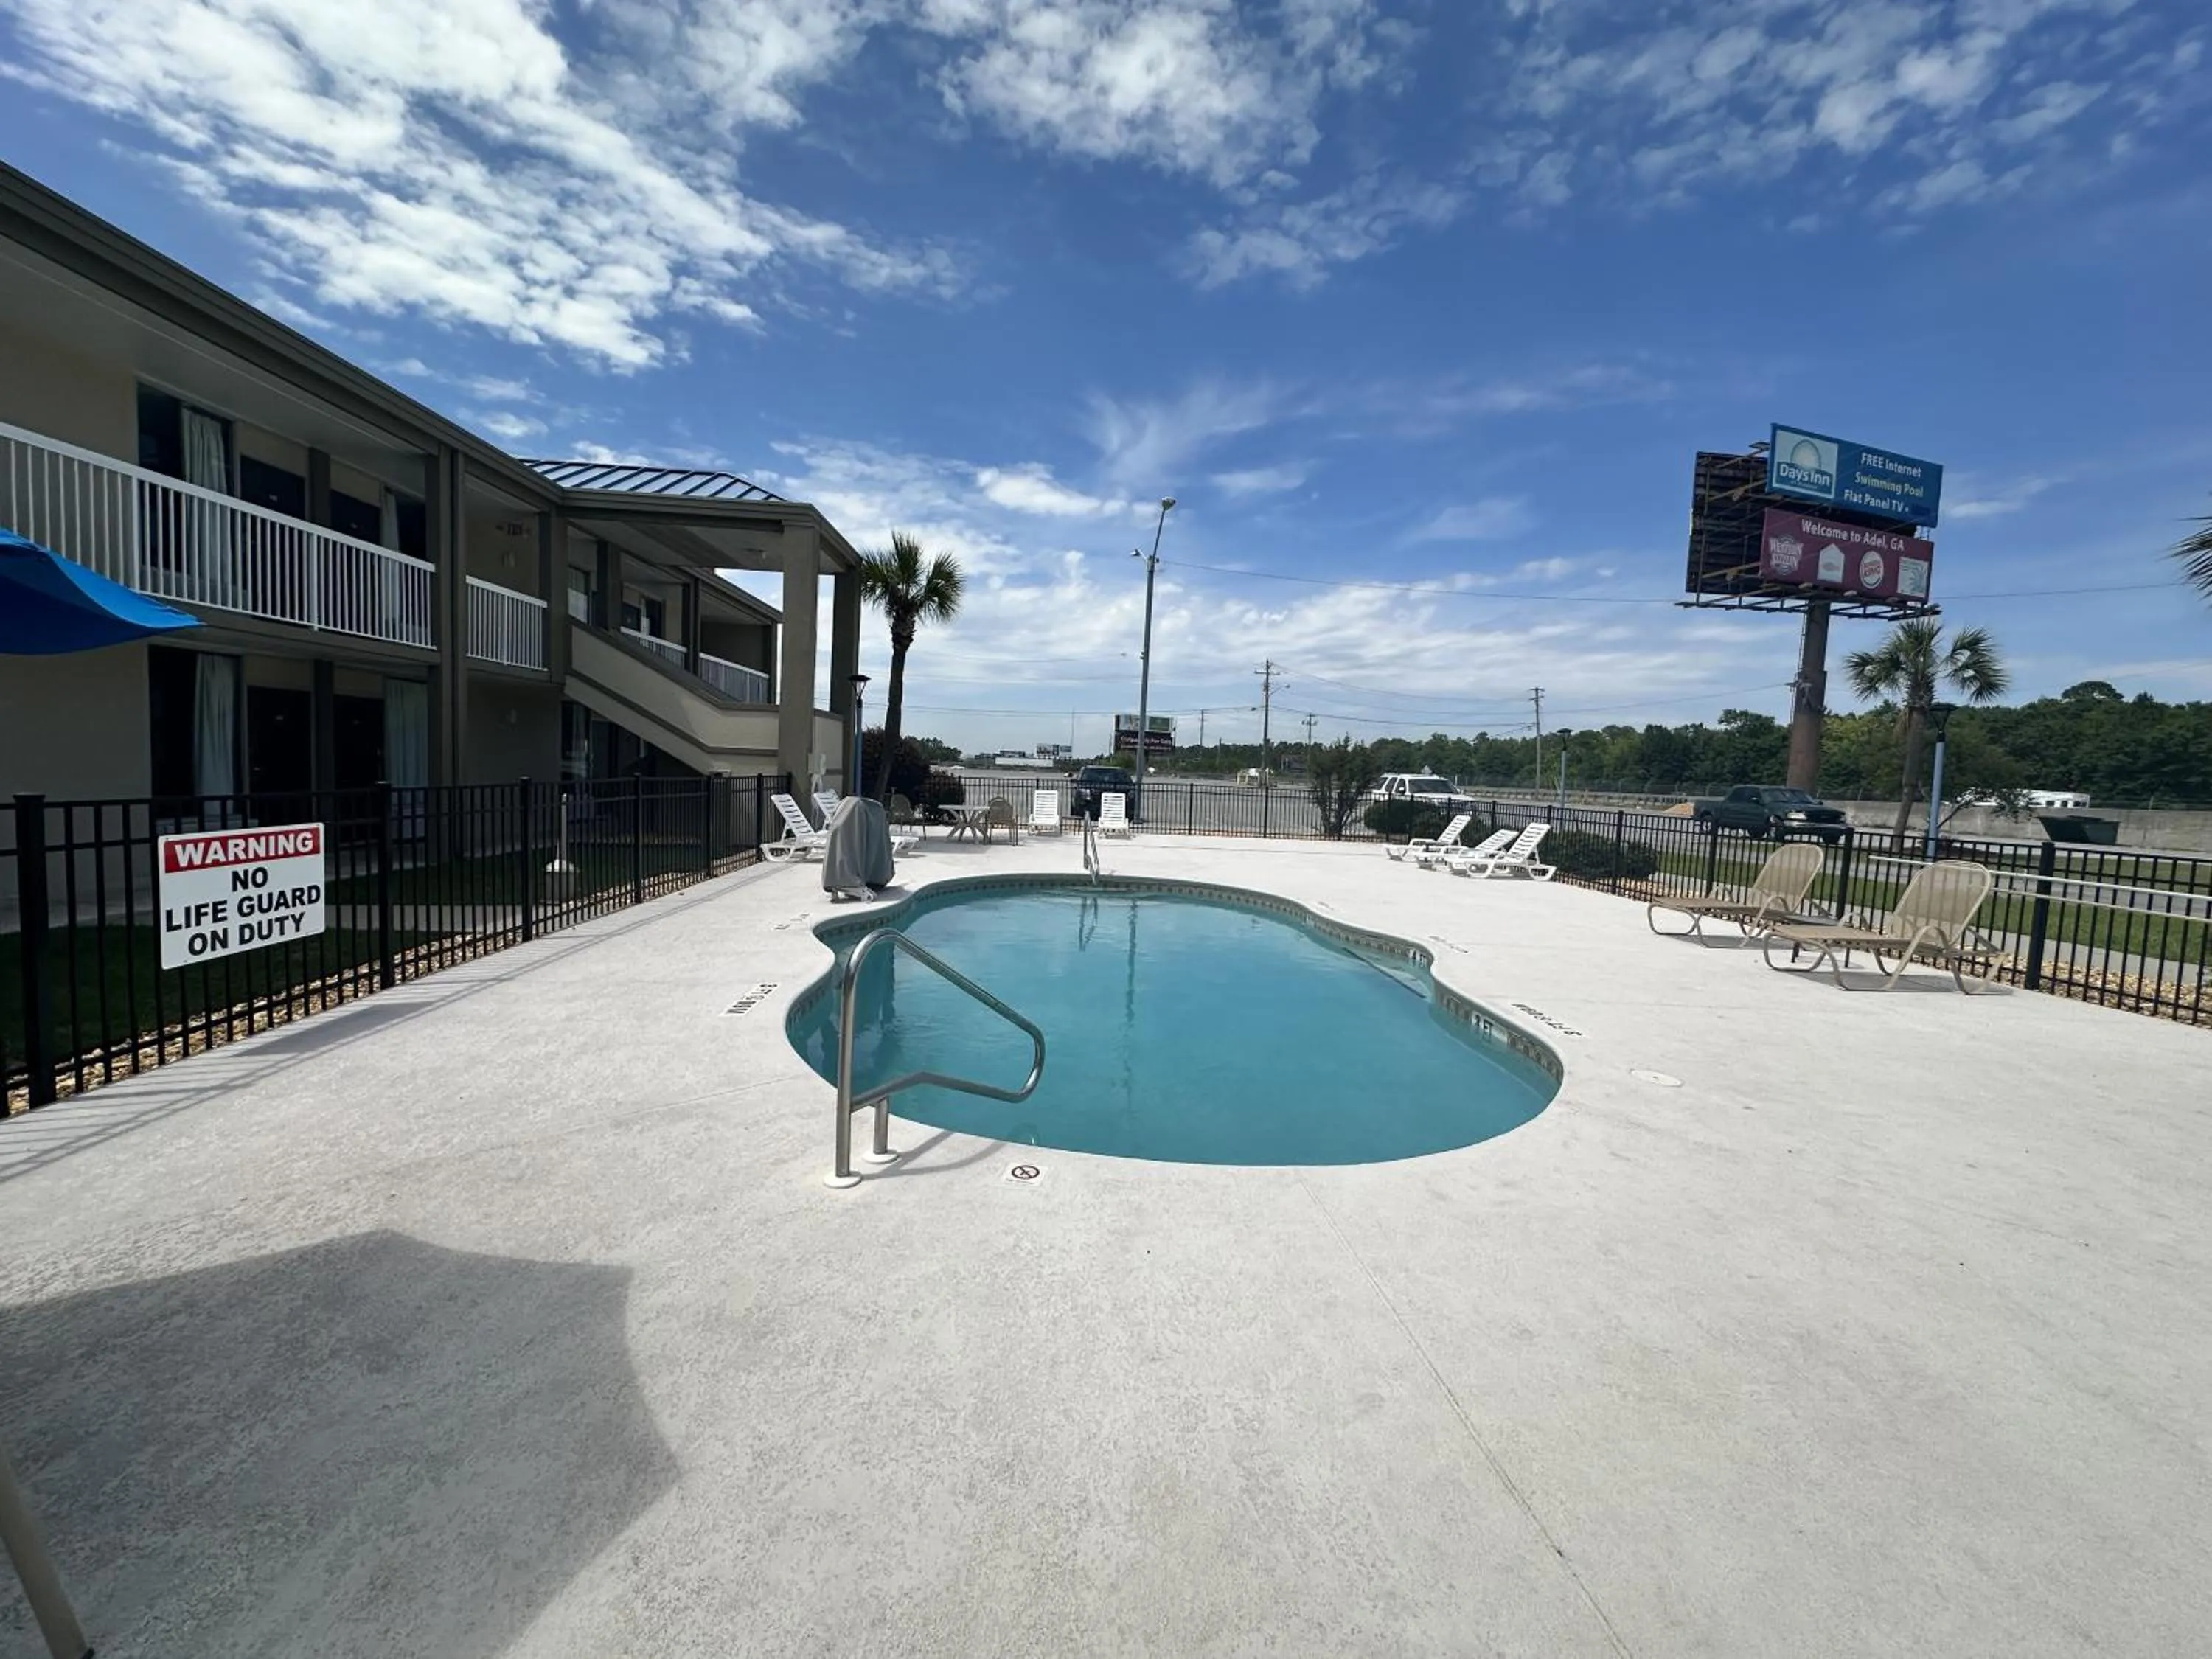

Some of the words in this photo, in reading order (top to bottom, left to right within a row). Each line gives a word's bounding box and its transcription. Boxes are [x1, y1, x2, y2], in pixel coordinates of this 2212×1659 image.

[1860, 452, 1884, 468] FREE
[1885, 459, 1921, 478] Internet
[1854, 471, 1902, 495] Swimming
[1903, 483, 1924, 498] Pool
[1843, 489, 1862, 504] Flat
[1863, 493, 1890, 509] Panel
[1891, 500, 1904, 512] TV
[1801, 518, 1848, 540] Welcome
[1850, 530, 1860, 542] to
[1890, 538, 1905, 552] GA
[175, 831, 314, 868] WARNING
[232, 866, 268, 891] NO
[165, 900, 228, 932] LIFE
[237, 884, 321, 918] GUARD
[188, 928, 229, 956] ON
[238, 911, 306, 945] DUTY
